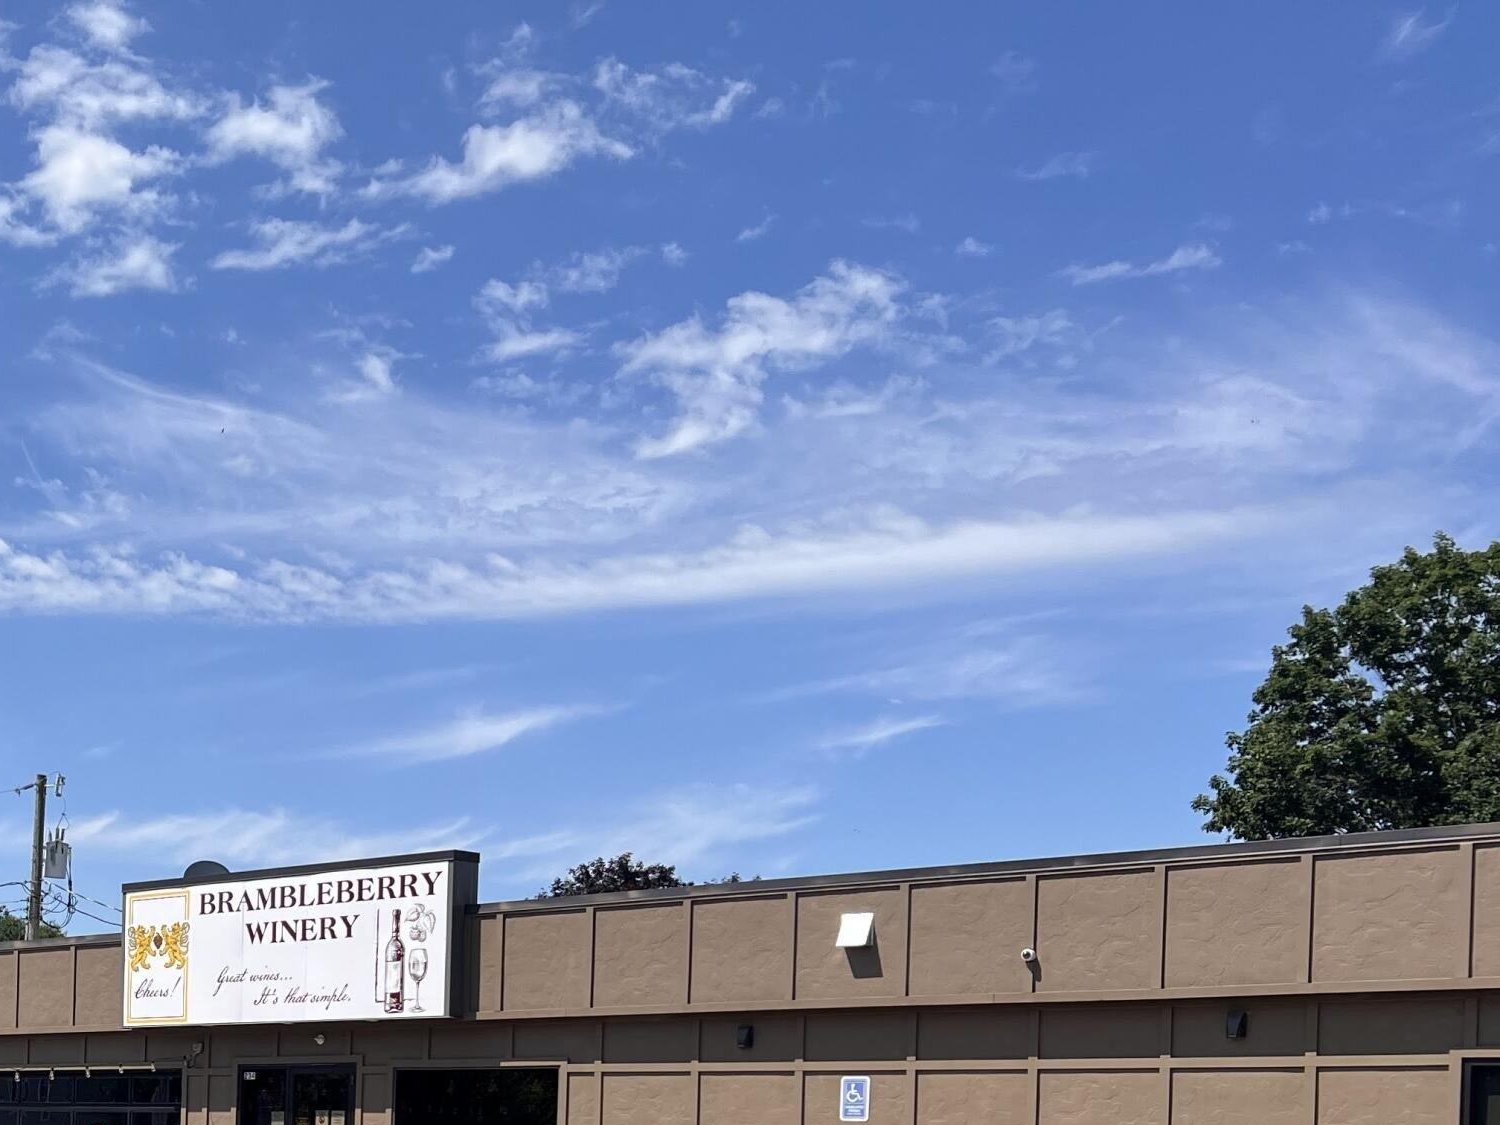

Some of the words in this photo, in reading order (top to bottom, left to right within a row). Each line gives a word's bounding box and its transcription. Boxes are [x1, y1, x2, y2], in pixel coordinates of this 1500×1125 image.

[199, 871, 443, 915] BRAMBLEBERRY
[245, 915, 360, 945] WINERY
[134, 976, 182, 999] Cheers!
[213, 966, 247, 997] Great
[253, 986, 279, 1006] It's
[283, 986, 309, 1004] that
[310, 983, 352, 1010] simple.
